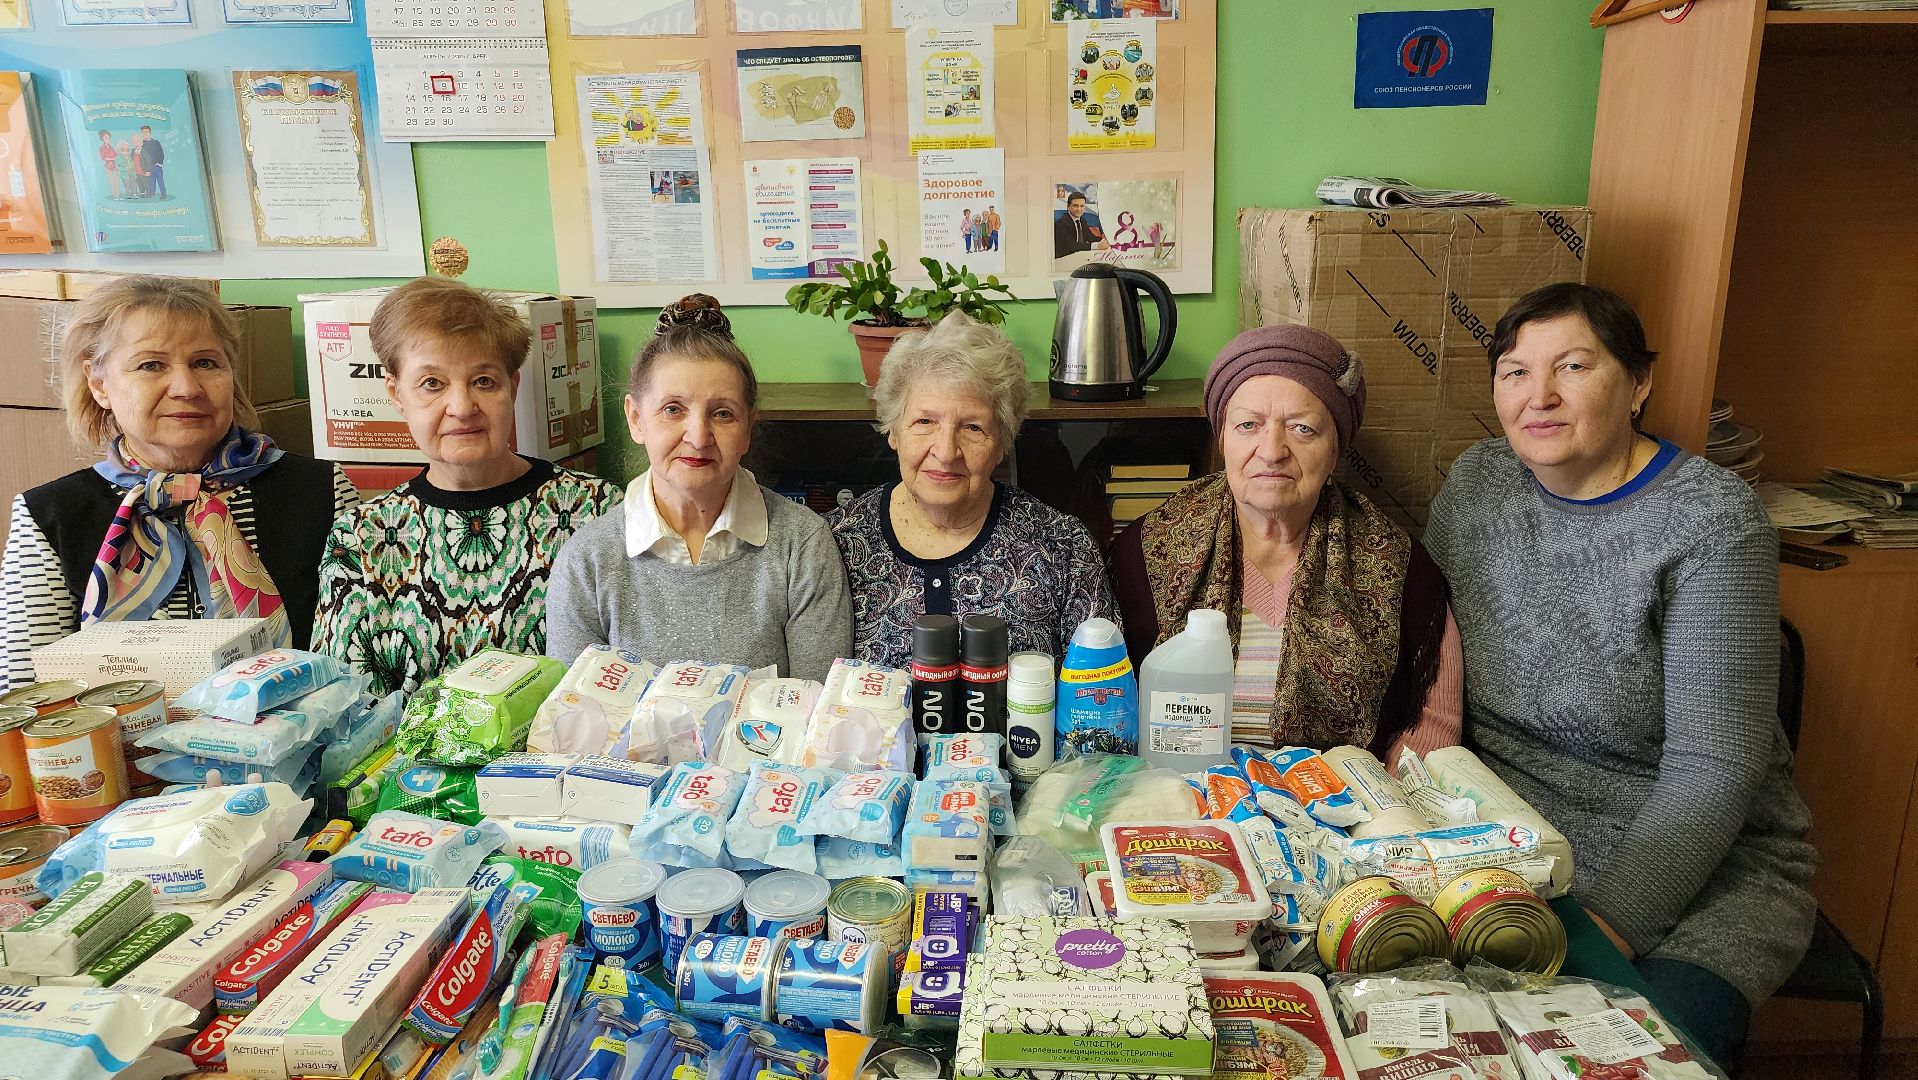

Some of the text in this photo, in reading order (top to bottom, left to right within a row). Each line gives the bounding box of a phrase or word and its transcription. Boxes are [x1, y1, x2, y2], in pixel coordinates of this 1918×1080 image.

[1395, 84, 1444, 93] ПЕНСИОНЕРОВ
[1445, 83, 1472, 91] РОССИИ
[923, 178, 983, 189] Здоровое
[923, 190, 995, 200] долголетие
[326, 342, 345, 353] ATF
[98, 663, 149, 677] традиции
[594, 662, 629, 692] tafo
[672, 666, 704, 688] tafo
[916, 668, 947, 680] ВЫГОДНЫЙ
[1070, 673, 1101, 681] ВЫГОДНАЯ
[1070, 708, 1101, 716] Шампунь
[1165, 703, 1212, 715] ПЕРЕКИСЬ
[122, 715, 162, 732] ЕЧНЕВАЯ
[1011, 734, 1038, 745] NIVEA
[1013, 743, 1033, 752] MEN
[683, 775, 716, 801] tafo
[851, 778, 882, 797] tafo
[1293, 771, 1324, 795] БИНТ
[768, 782, 798, 814] tafo
[700, 819, 711, 833] 20
[380, 827, 434, 848] tafo
[1124, 837, 1229, 856] Доширак
[146, 868, 205, 883] ТЕРИАЛЬНЫЕ
[0, 883, 35, 896] ГРЕЧН
[189, 880, 276, 948] ACTIDENT
[592, 910, 637, 926] СВЕТАЕВО
[1353, 899, 1384, 922] ОМКК
[783, 916, 825, 939] СВЕТАЕВО
[96, 916, 175, 974] БАННОЕ
[229, 912, 312, 978] Colgate
[594, 933, 635, 945] МОЛОКО
[1058, 939, 1121, 954] pretty
[300, 914, 374, 986] ACTIDENT
[343, 930, 417, 1004] ACTIDENT
[437, 926, 493, 1006] Colgate
[540, 940, 563, 980] Colgate
[174, 968, 212, 1001] SENSITIVE
[214, 979, 248, 990] Colgate
[598, 975, 610, 991] 5
[1067, 984, 1122, 992] САЛФЕТКИ
[1058, 992, 1118, 1000] медицинские
[1119, 993, 1180, 1001] СТЕРИЛЬНЫЕ
[421, 1000, 454, 1026] Colgate
[232, 1044, 280, 1056] ACTIDENT
[1073, 1039, 1124, 1048] САЛФЕТКИ
[1021, 1046, 1175, 1058] марлевые медицинские СТЕРИЛЬНЫЕ
[1384, 1057, 1425, 1075] Кисель
